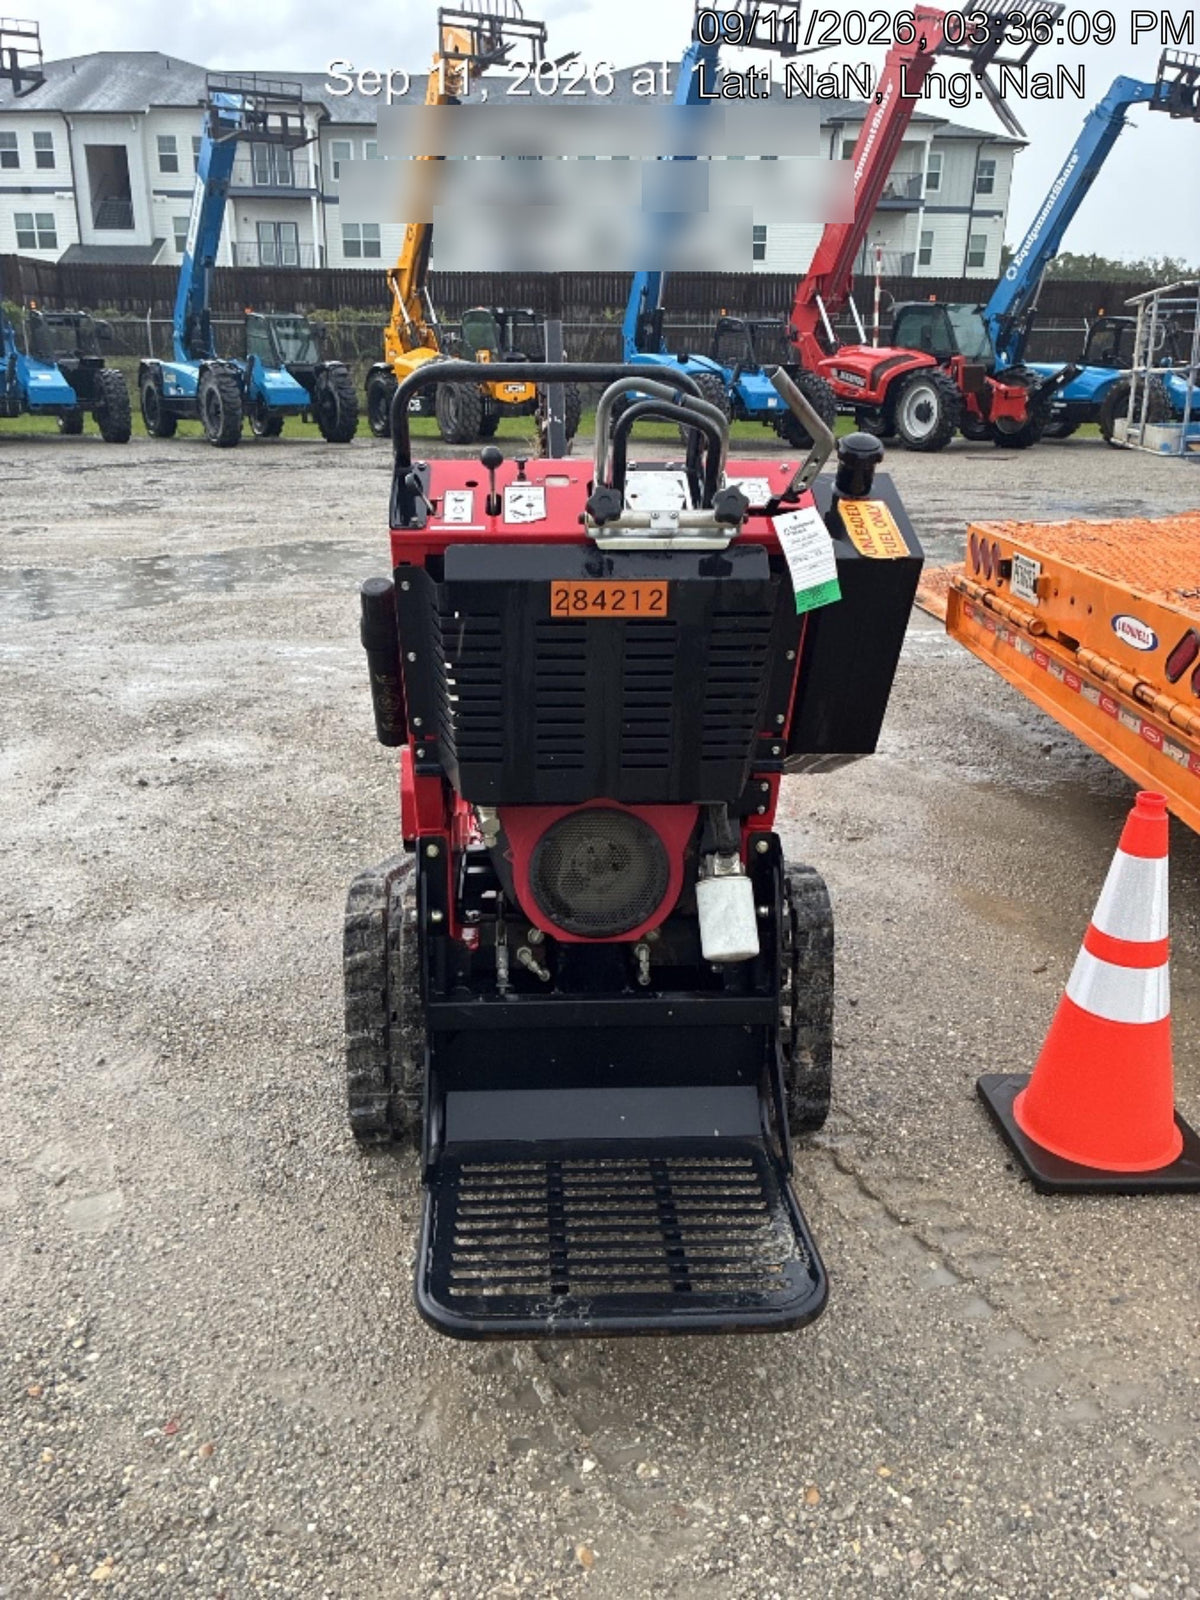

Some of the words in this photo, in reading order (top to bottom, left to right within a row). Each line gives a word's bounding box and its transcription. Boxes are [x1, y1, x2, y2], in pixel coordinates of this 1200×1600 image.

[864, 504, 888, 529] ONLY
[844, 503, 878, 556] UNLEADED
[880, 531, 901, 555] FUEL
[555, 589, 664, 611] 284212
